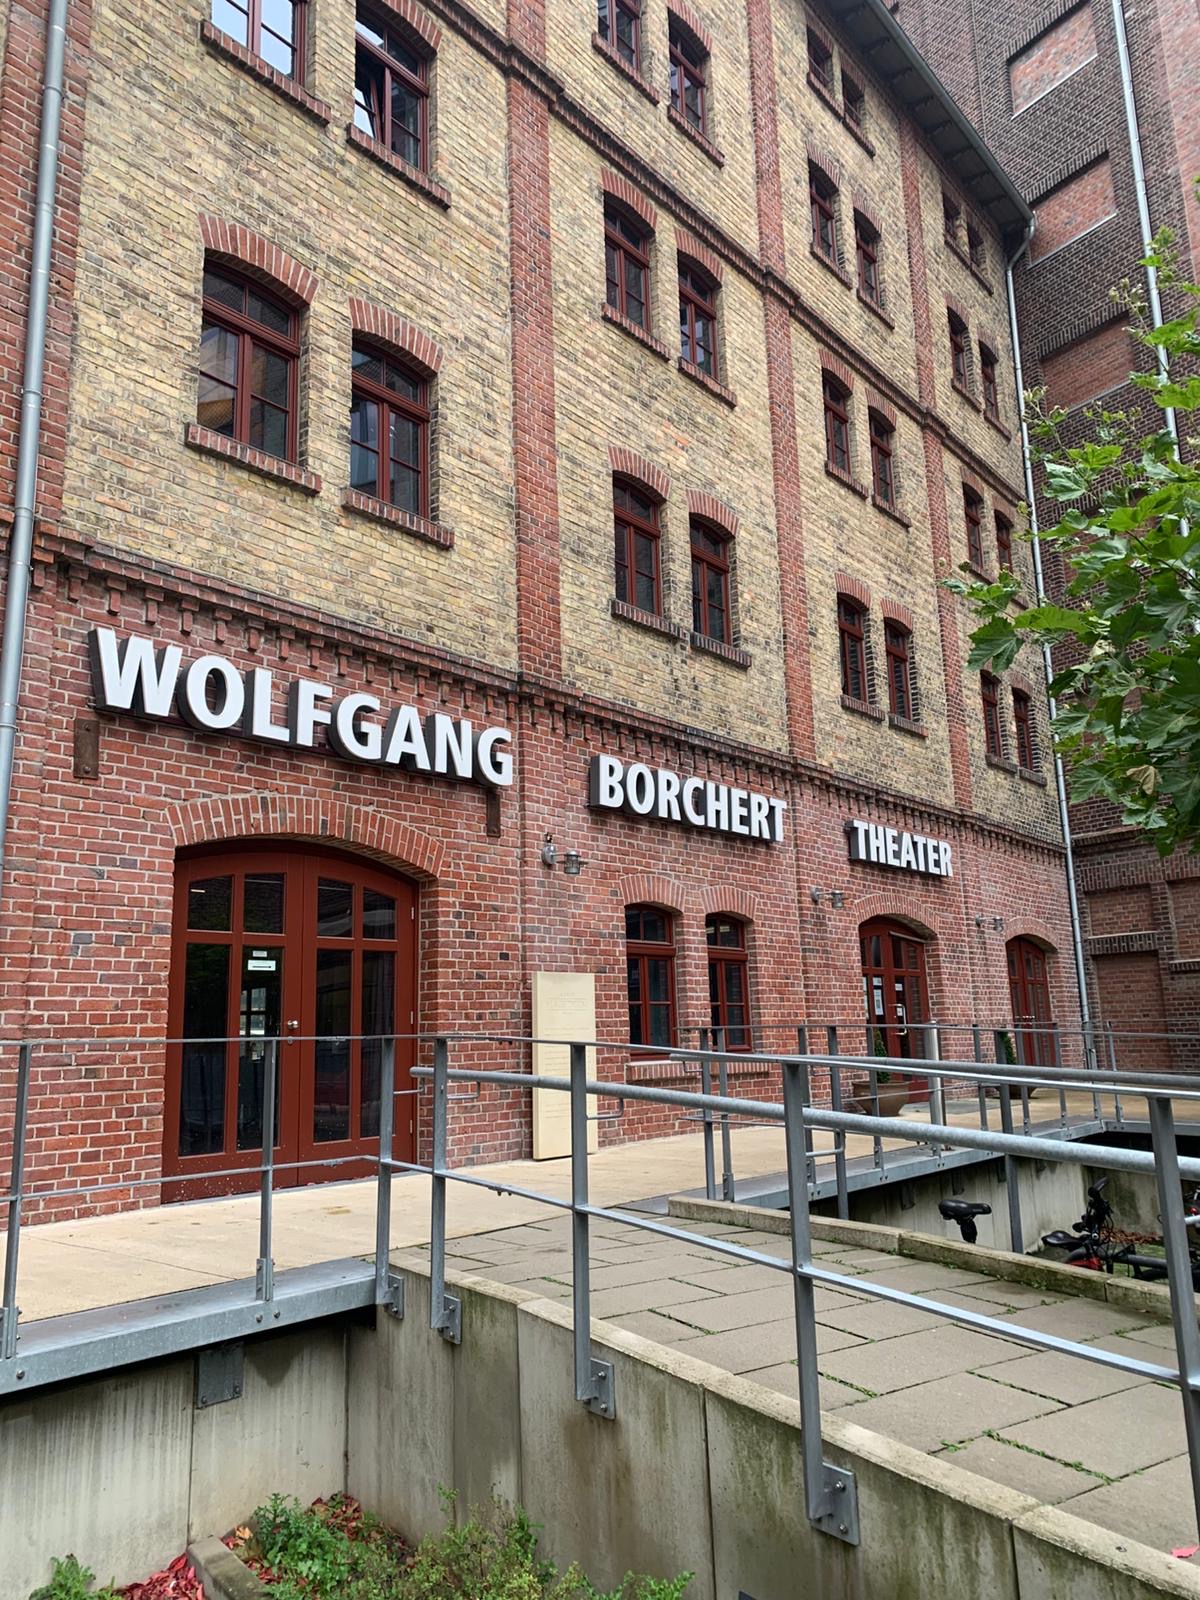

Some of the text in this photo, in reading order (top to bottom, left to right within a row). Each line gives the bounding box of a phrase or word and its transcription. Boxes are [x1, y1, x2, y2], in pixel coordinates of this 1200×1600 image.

[96, 628, 954, 877] WOLFGANG BORCHERT THEATER
